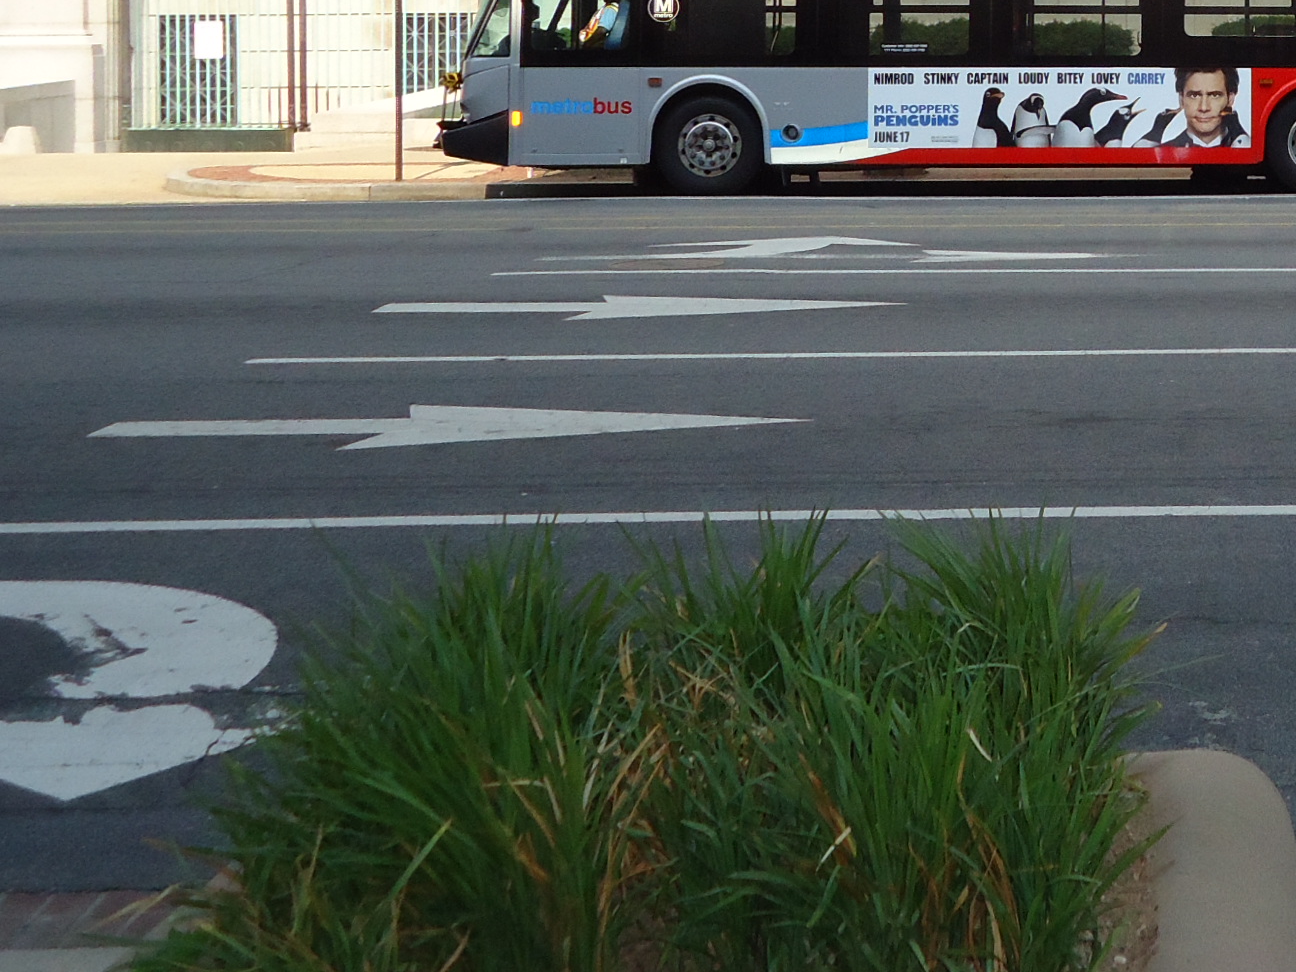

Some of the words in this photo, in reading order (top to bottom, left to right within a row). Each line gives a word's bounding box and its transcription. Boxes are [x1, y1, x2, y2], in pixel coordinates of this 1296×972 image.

[873, 73, 914, 85] NIMROD
[923, 73, 960, 85] STINKY
[966, 73, 1009, 85] CAPTAIN
[1018, 73, 1050, 85] LOUDY
[1056, 73, 1084, 85] BITEY
[1091, 73, 1121, 85] LOVEY
[1127, 73, 1166, 85] CARREY
[531, 97, 632, 115] metrobus
[873, 104, 897, 114] MR.
[900, 104, 960, 114] POPPER'S
[873, 131, 898, 143] JUNE
[899, 131, 910, 143] 17
